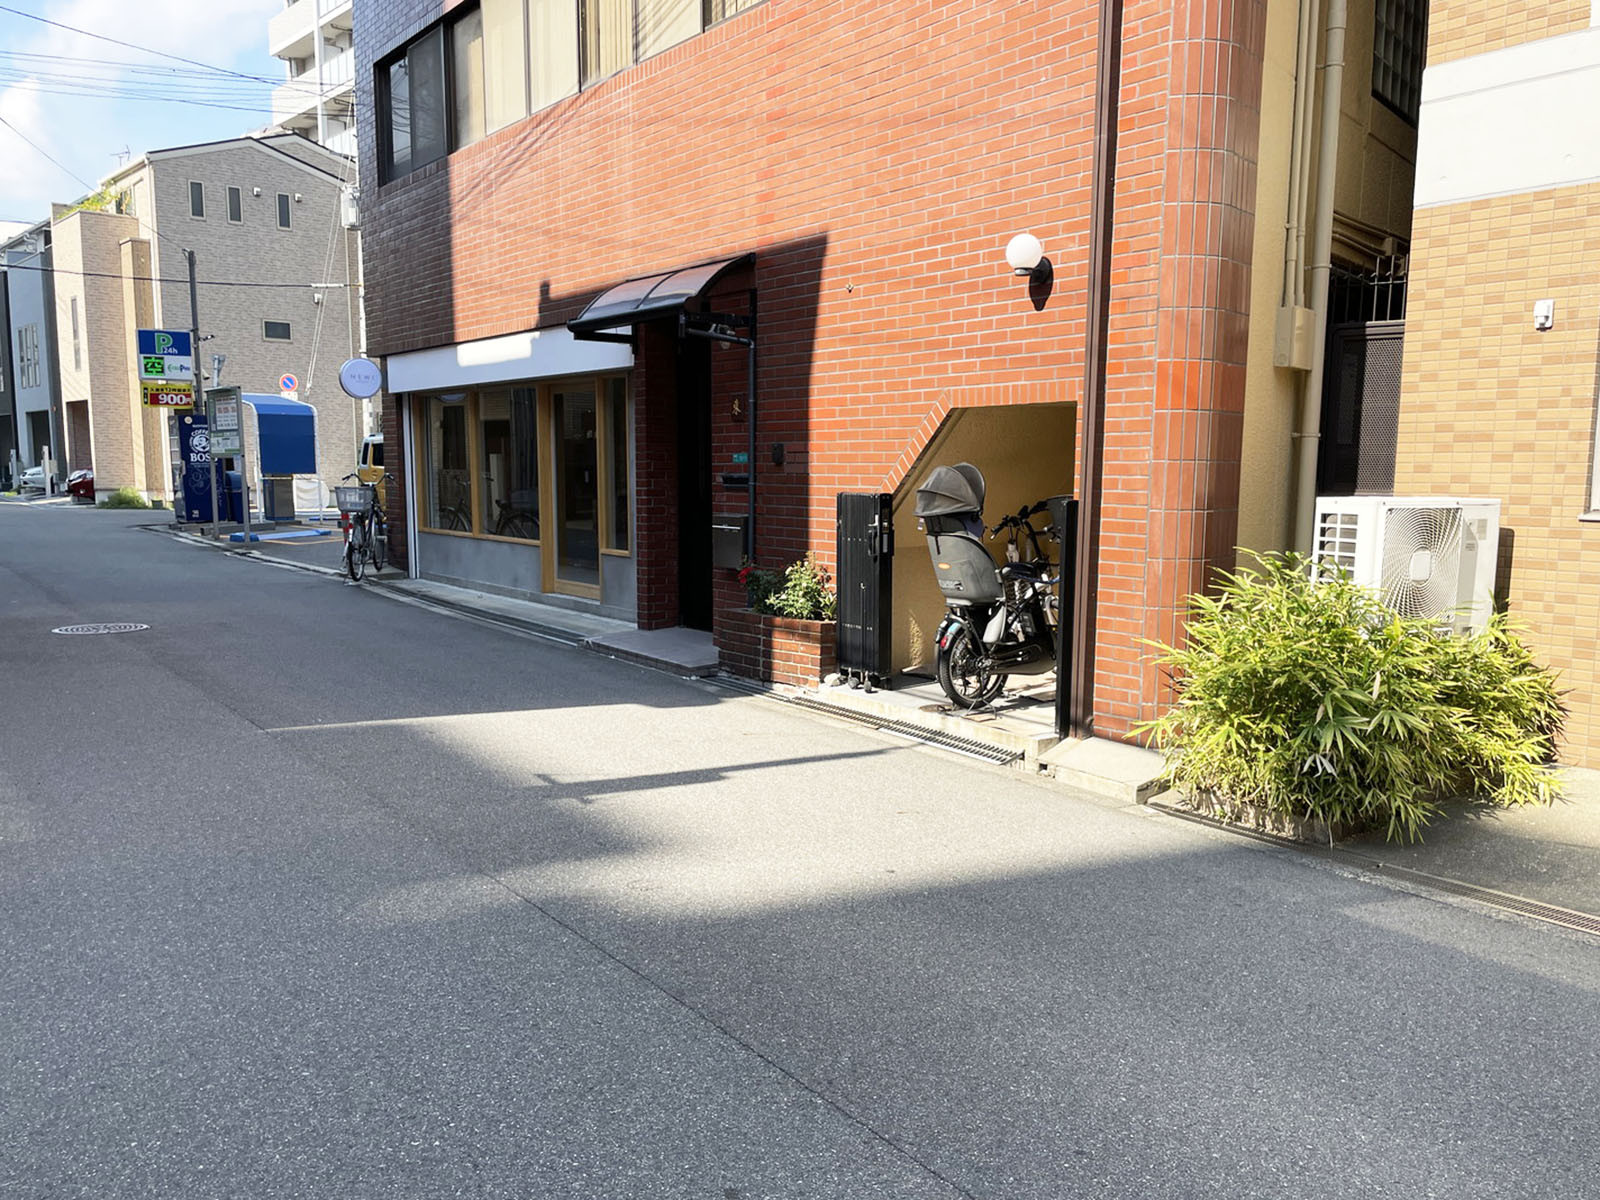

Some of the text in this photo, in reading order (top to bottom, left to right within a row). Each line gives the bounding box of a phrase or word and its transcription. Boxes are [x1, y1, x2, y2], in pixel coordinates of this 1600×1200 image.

[154, 332, 178, 354] P 24h
[143, 356, 165, 376] 空
[190, 453, 218, 462] BOS
